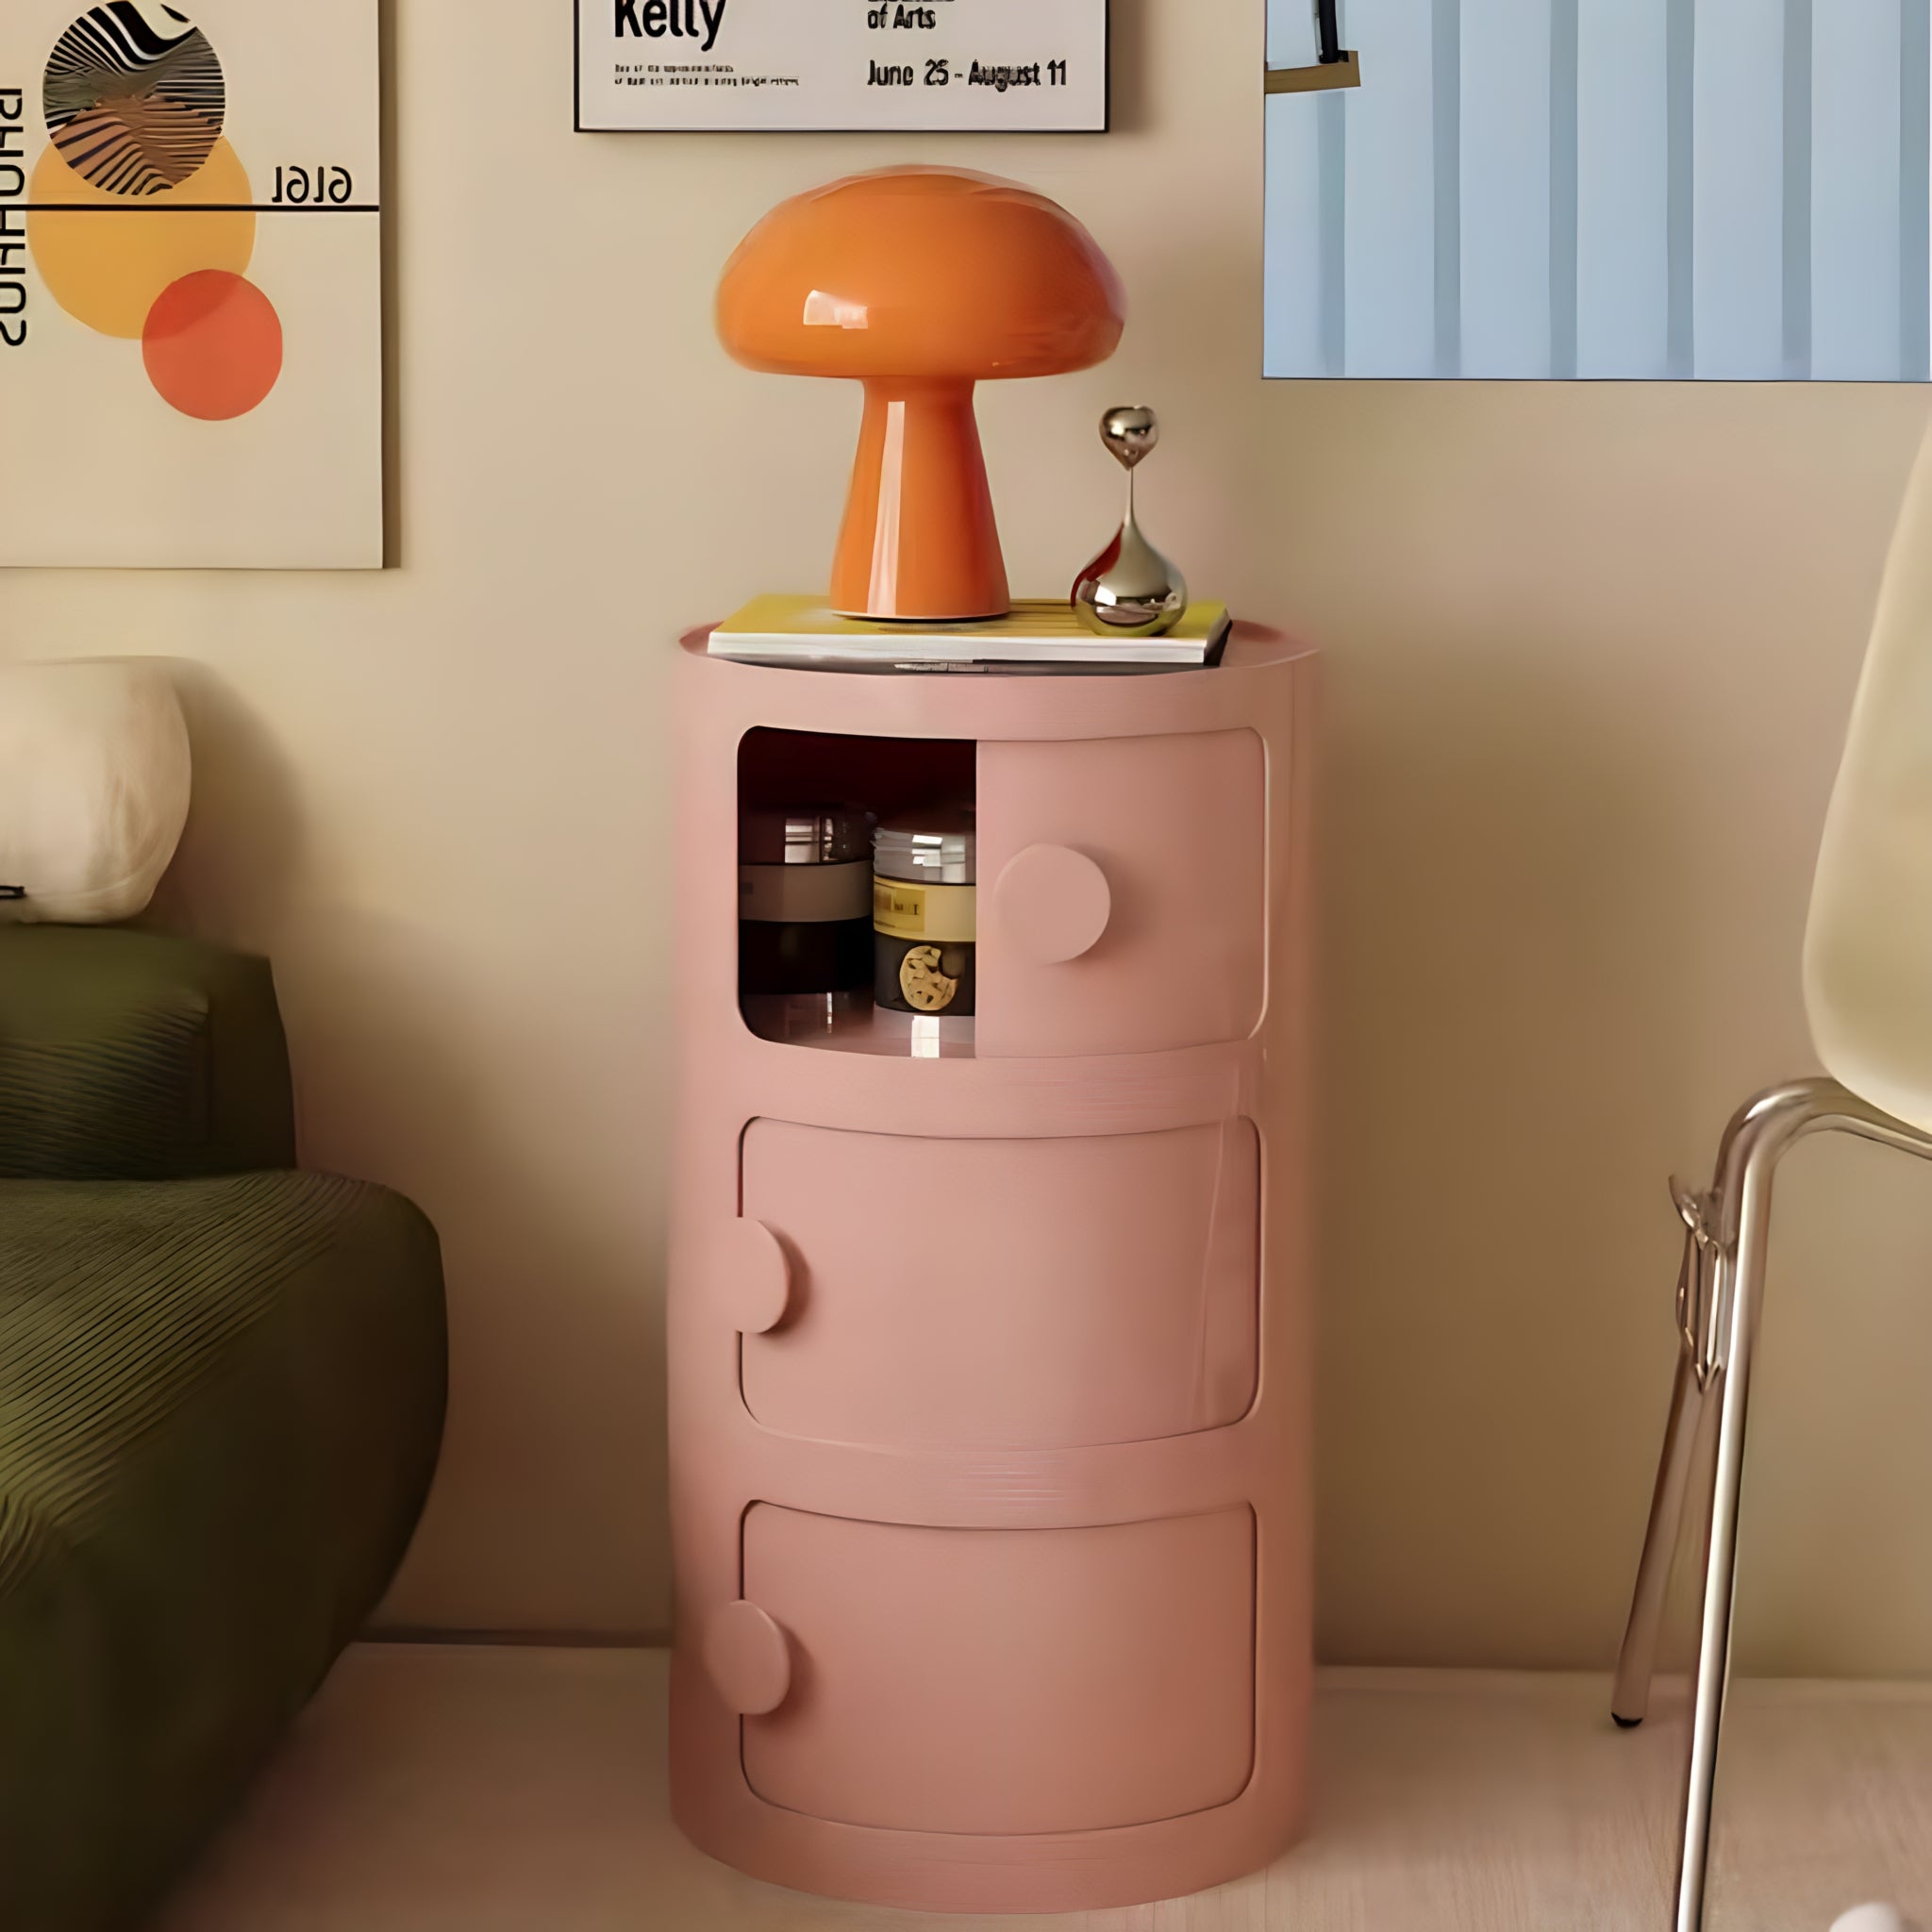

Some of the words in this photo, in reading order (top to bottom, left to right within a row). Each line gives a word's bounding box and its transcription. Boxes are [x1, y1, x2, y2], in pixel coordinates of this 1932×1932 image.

[614, 0, 725, 52] Kelly
[867, 3, 888, 29] of
[892, 4, 937, 29] Arts
[867, 59, 913, 86] June
[968, 58, 1041, 92] August
[1046, 59, 1067, 86] 11
